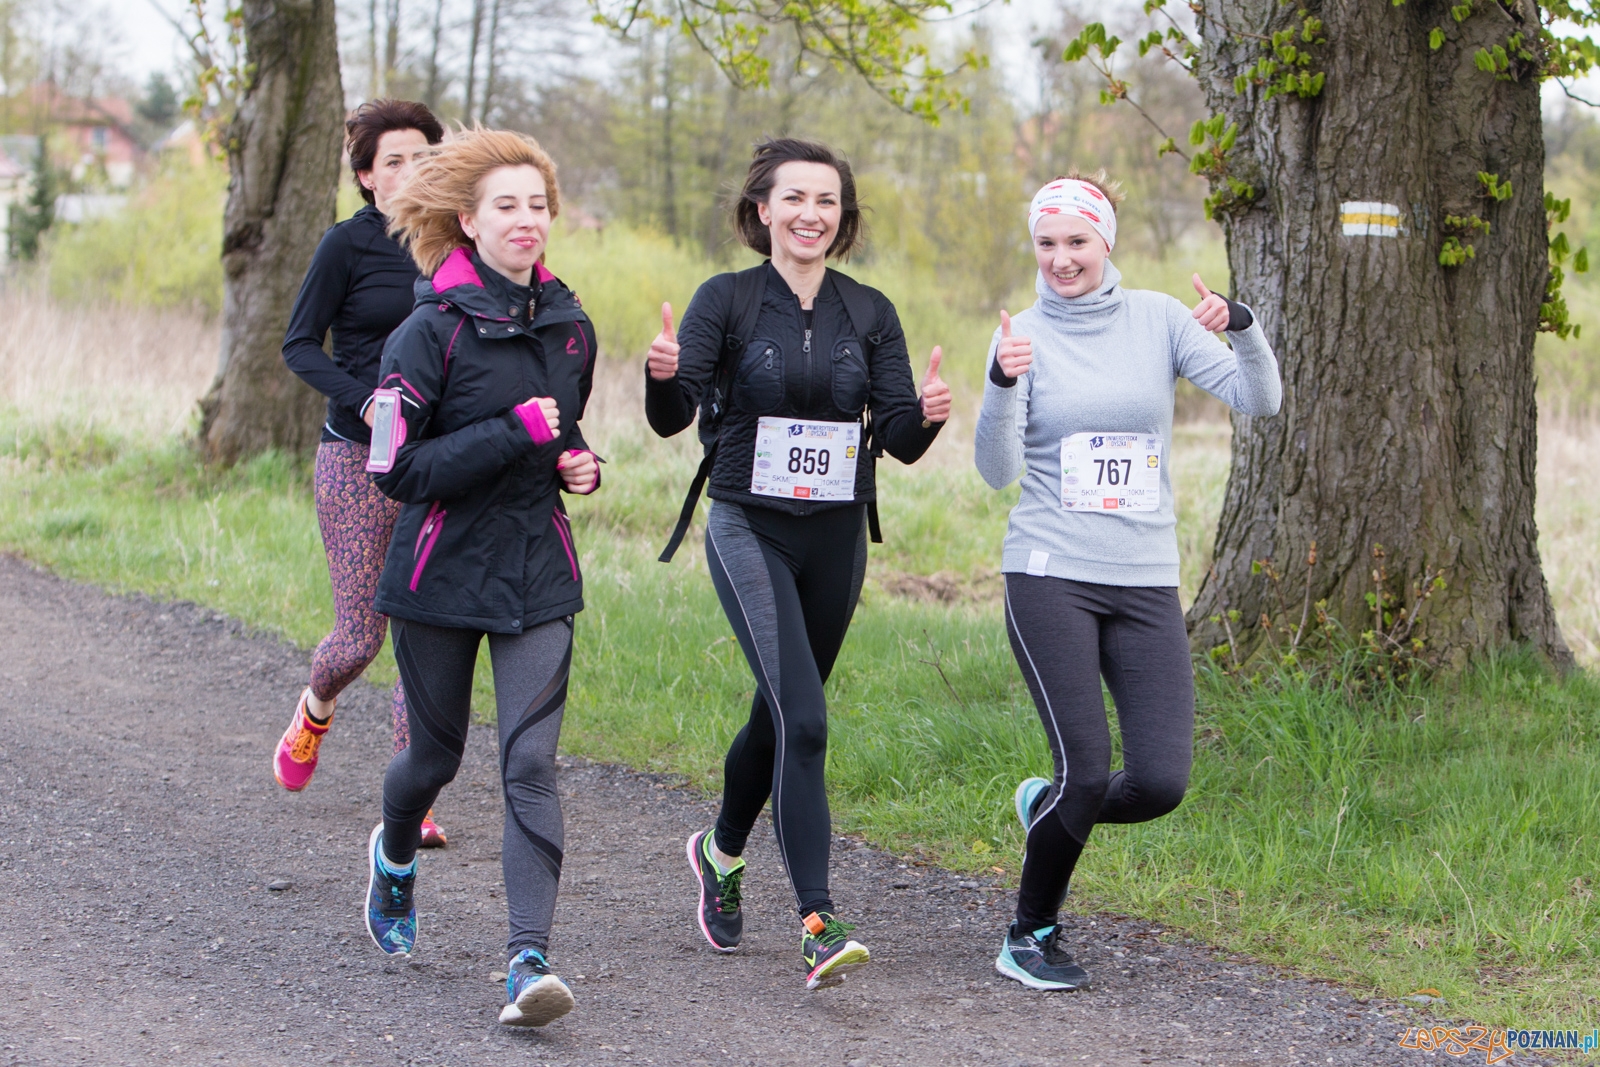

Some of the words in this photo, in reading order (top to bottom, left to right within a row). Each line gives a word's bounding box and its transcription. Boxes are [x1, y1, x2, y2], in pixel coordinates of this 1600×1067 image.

[788, 447, 830, 475] 859
[1093, 458, 1132, 486] 767
[772, 475, 789, 483] 5KM
[822, 478, 840, 486] 10KM
